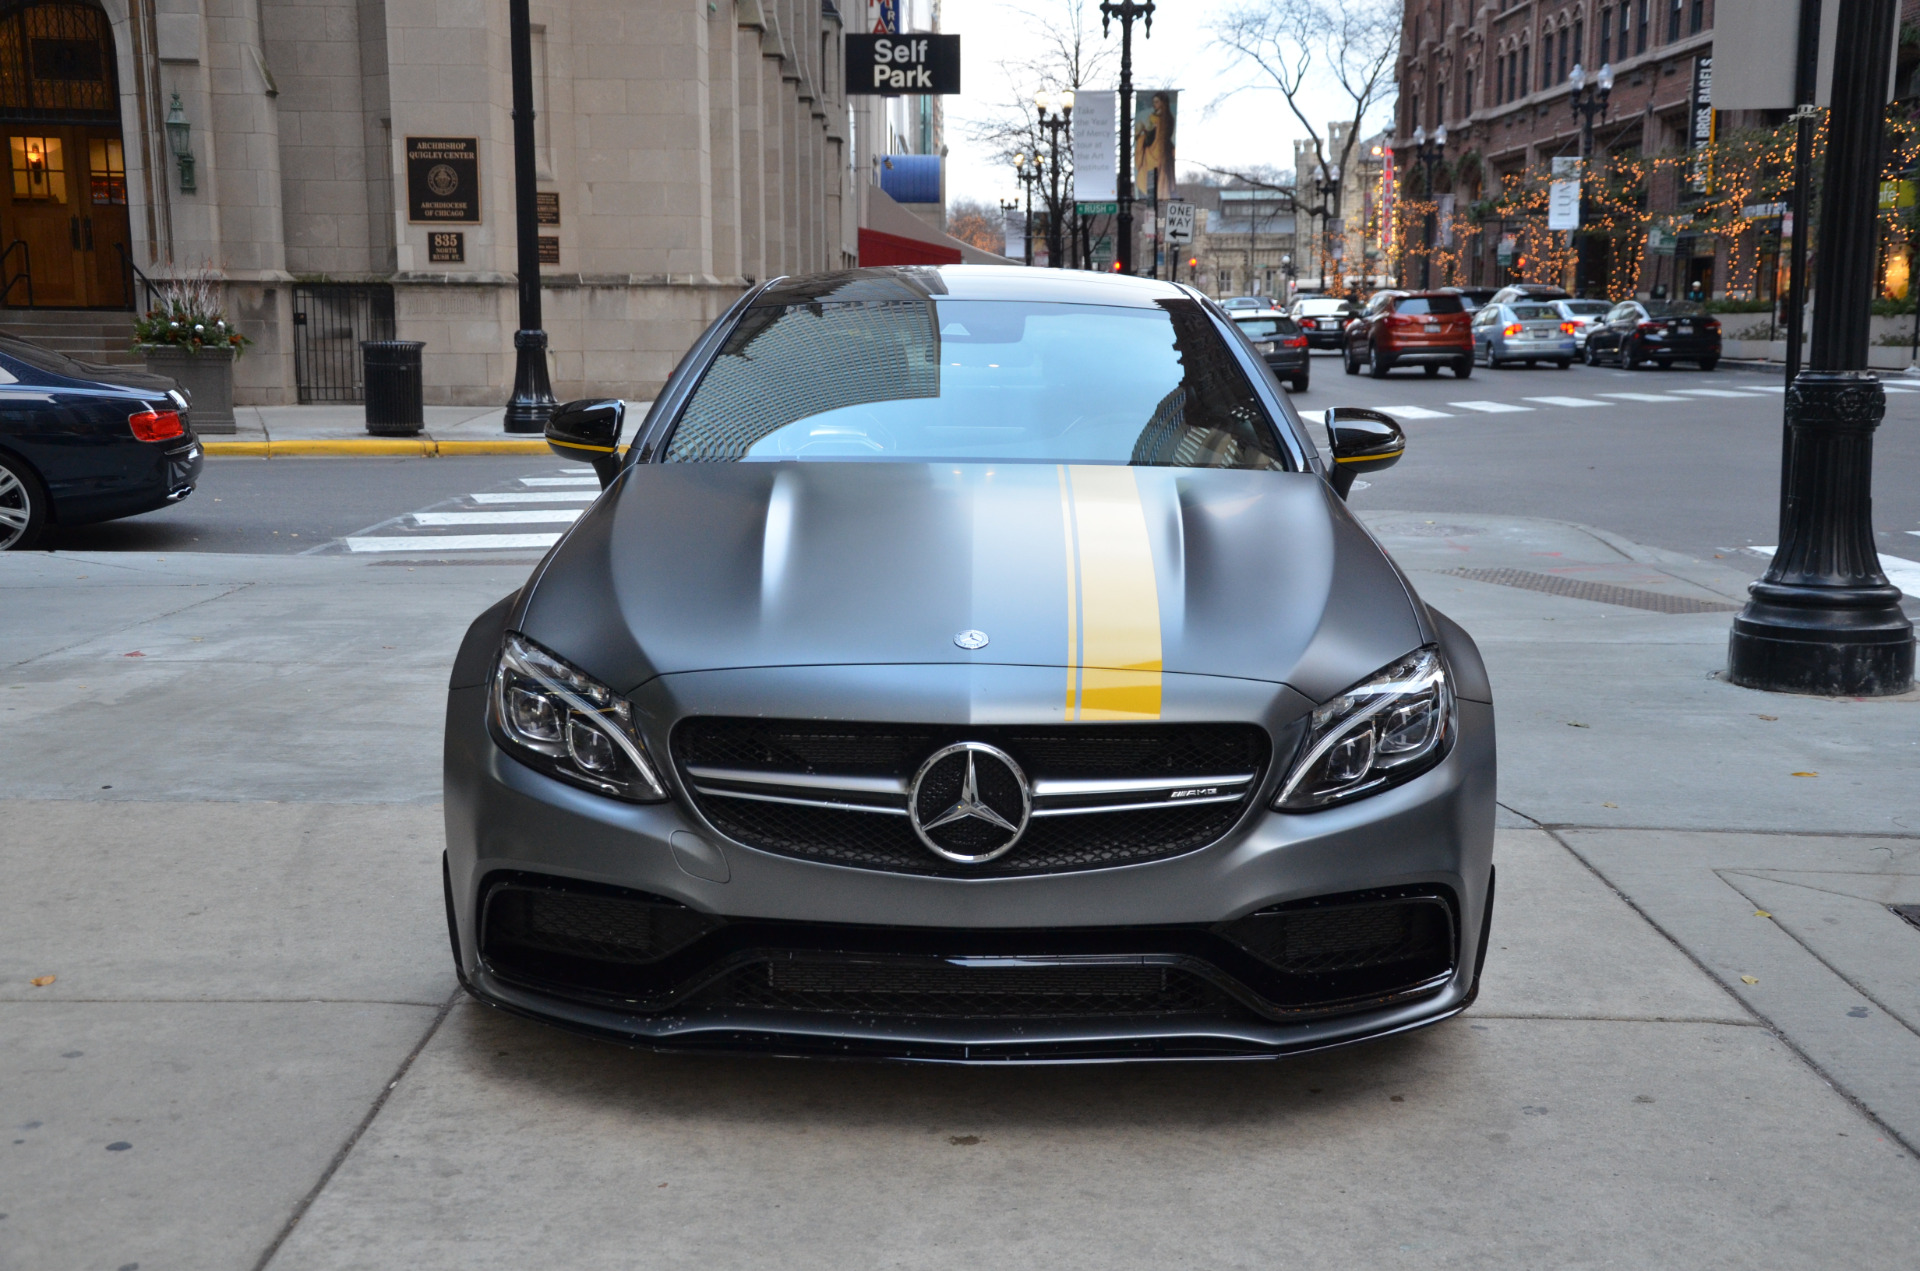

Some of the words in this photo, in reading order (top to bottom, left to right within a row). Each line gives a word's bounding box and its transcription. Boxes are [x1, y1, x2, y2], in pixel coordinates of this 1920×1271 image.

[874, 39, 928, 63] Self
[874, 64, 932, 88] Park
[1077, 106, 1094, 114] Take
[1087, 130, 1110, 138] Mercy
[417, 142, 466, 150] ARCHBISHOP
[1084, 204, 1107, 213] RUSH
[1170, 205, 1191, 216] ONE
[1169, 217, 1191, 227] WAY
[435, 234, 457, 246] 835
[1185, 788, 1217, 796] AMG
